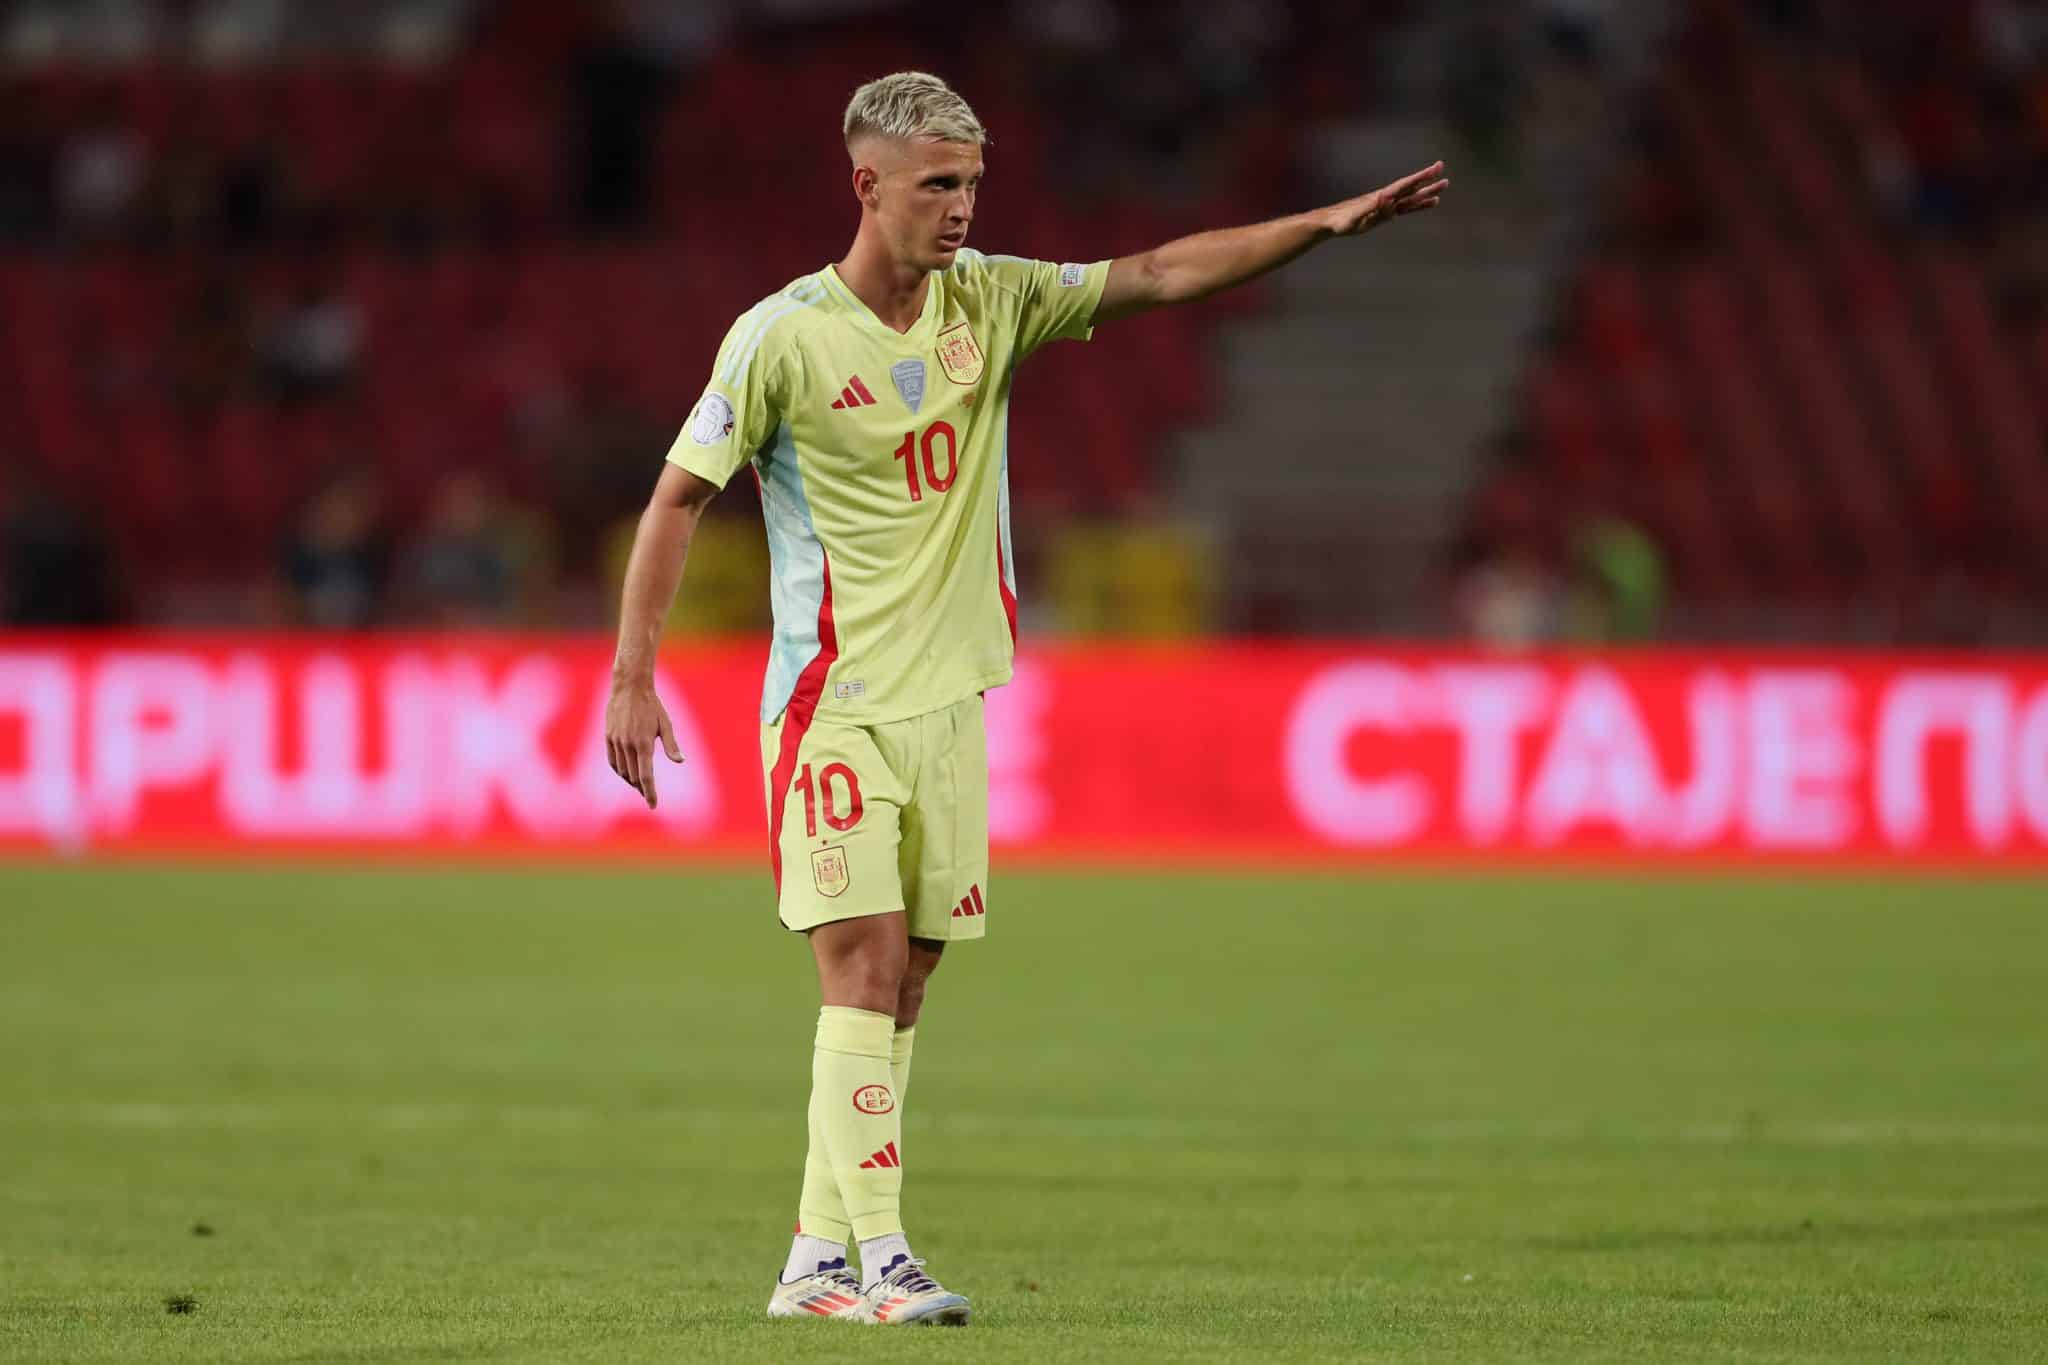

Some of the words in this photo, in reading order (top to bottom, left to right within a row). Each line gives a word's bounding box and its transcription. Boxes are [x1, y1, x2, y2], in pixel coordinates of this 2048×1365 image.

[894, 420, 958, 501] 10
[794, 762, 864, 838] 10
[1876, 672, 2048, 848] П
